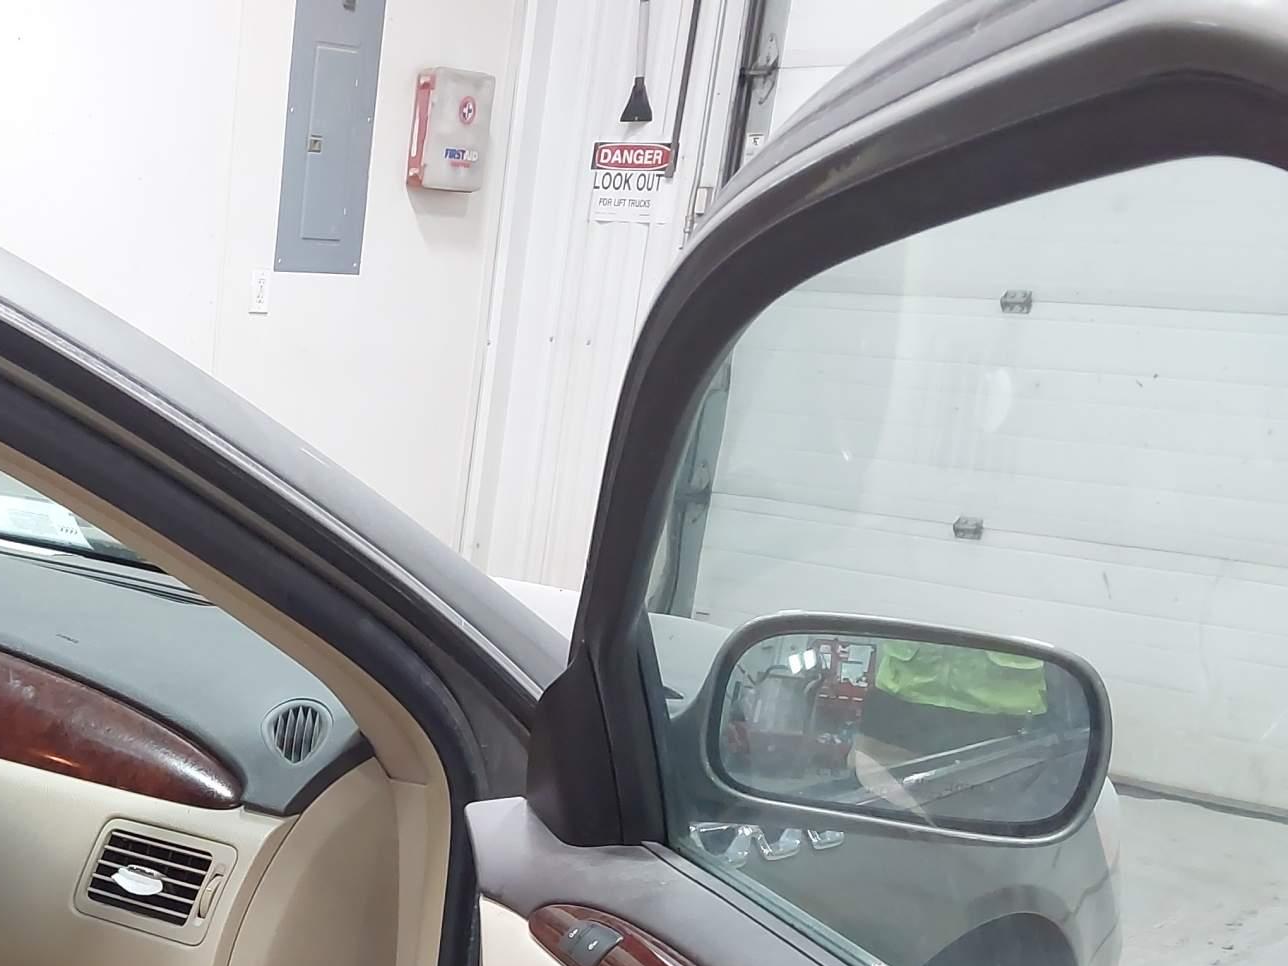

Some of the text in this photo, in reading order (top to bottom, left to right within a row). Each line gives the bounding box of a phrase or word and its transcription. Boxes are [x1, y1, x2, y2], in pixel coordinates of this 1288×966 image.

[599, 148, 663, 165] DANGER
[592, 171, 665, 192] LOOK OUT
